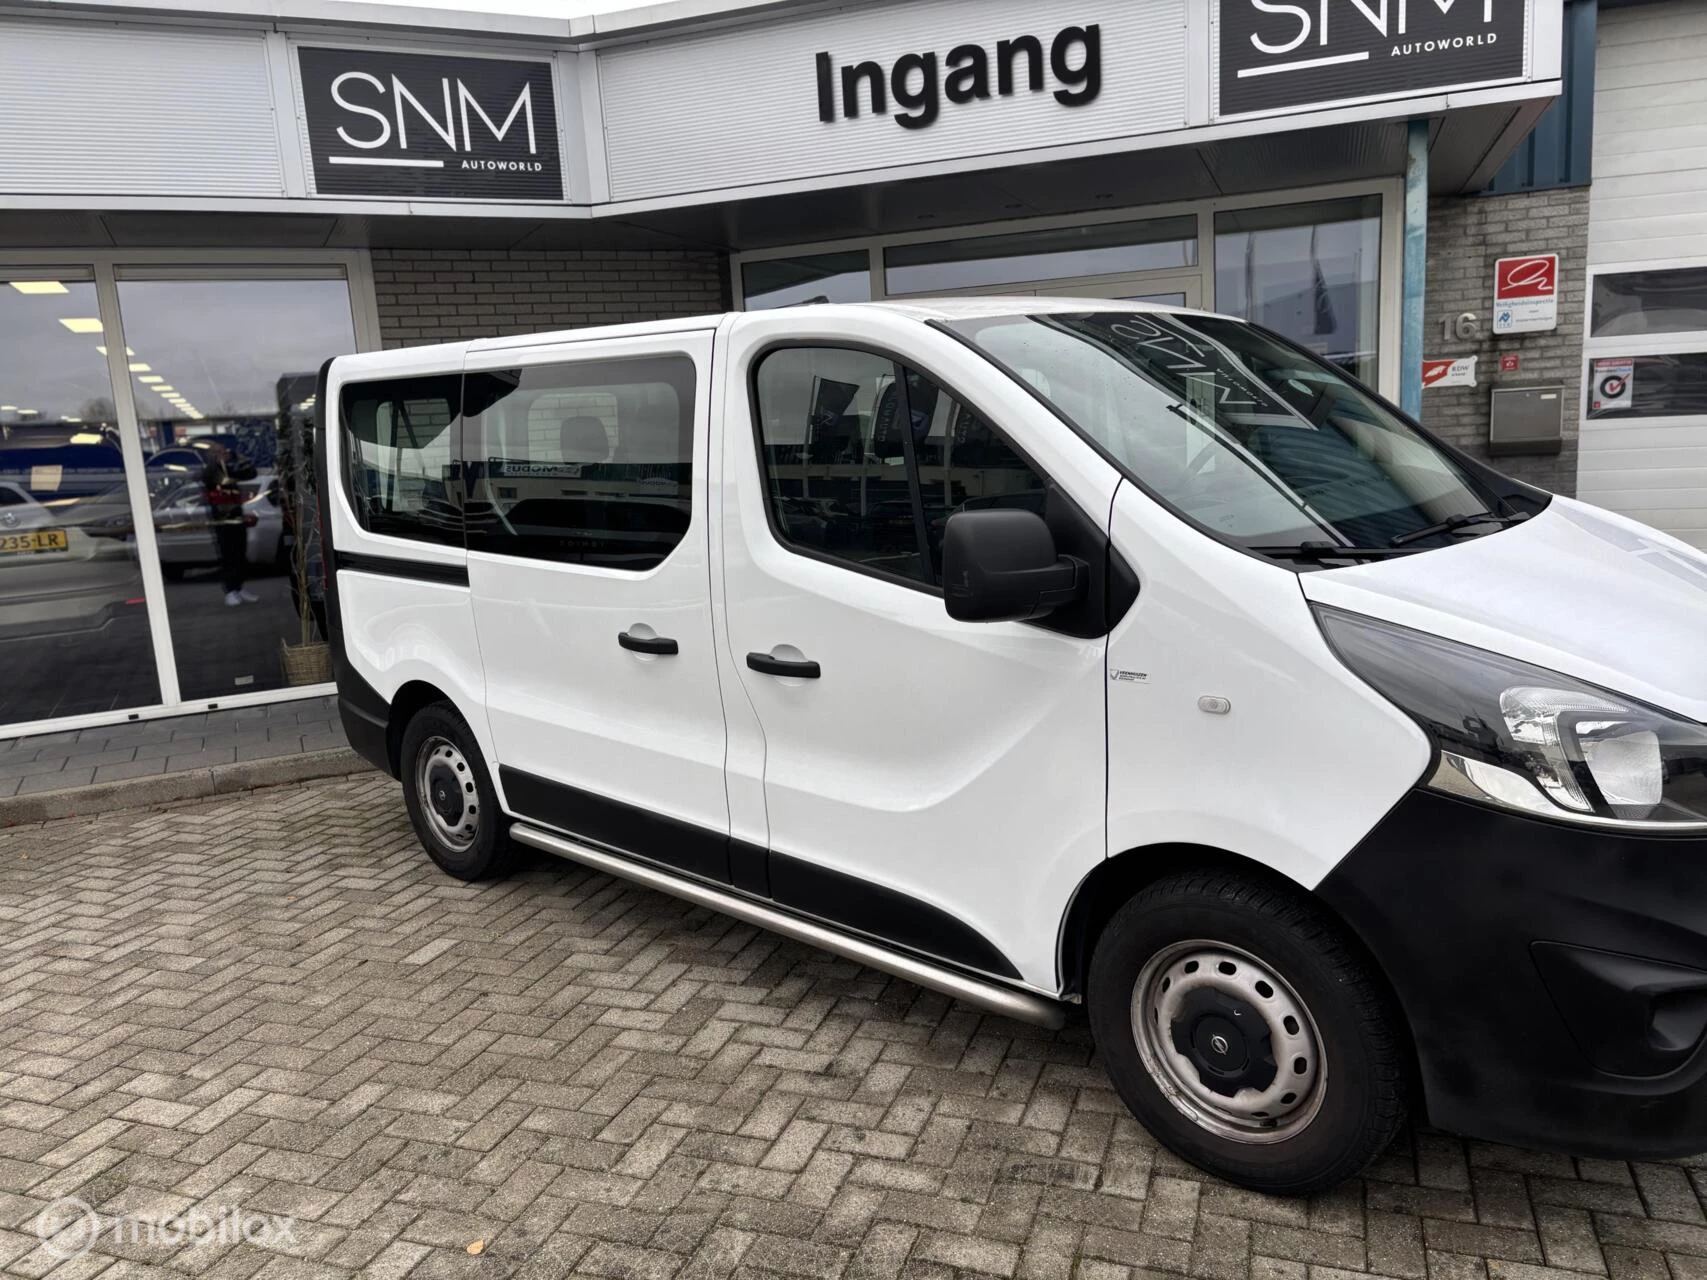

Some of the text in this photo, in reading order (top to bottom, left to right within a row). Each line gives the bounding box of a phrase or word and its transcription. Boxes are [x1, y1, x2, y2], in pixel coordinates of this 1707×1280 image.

[1391, 32, 1498, 57] AUTOWORLD
[815, 23, 1102, 130] Ingang
[331, 71, 537, 155] SNM
[461, 159, 543, 172] AUTOWORLD
[1438, 312, 1478, 341] 16
